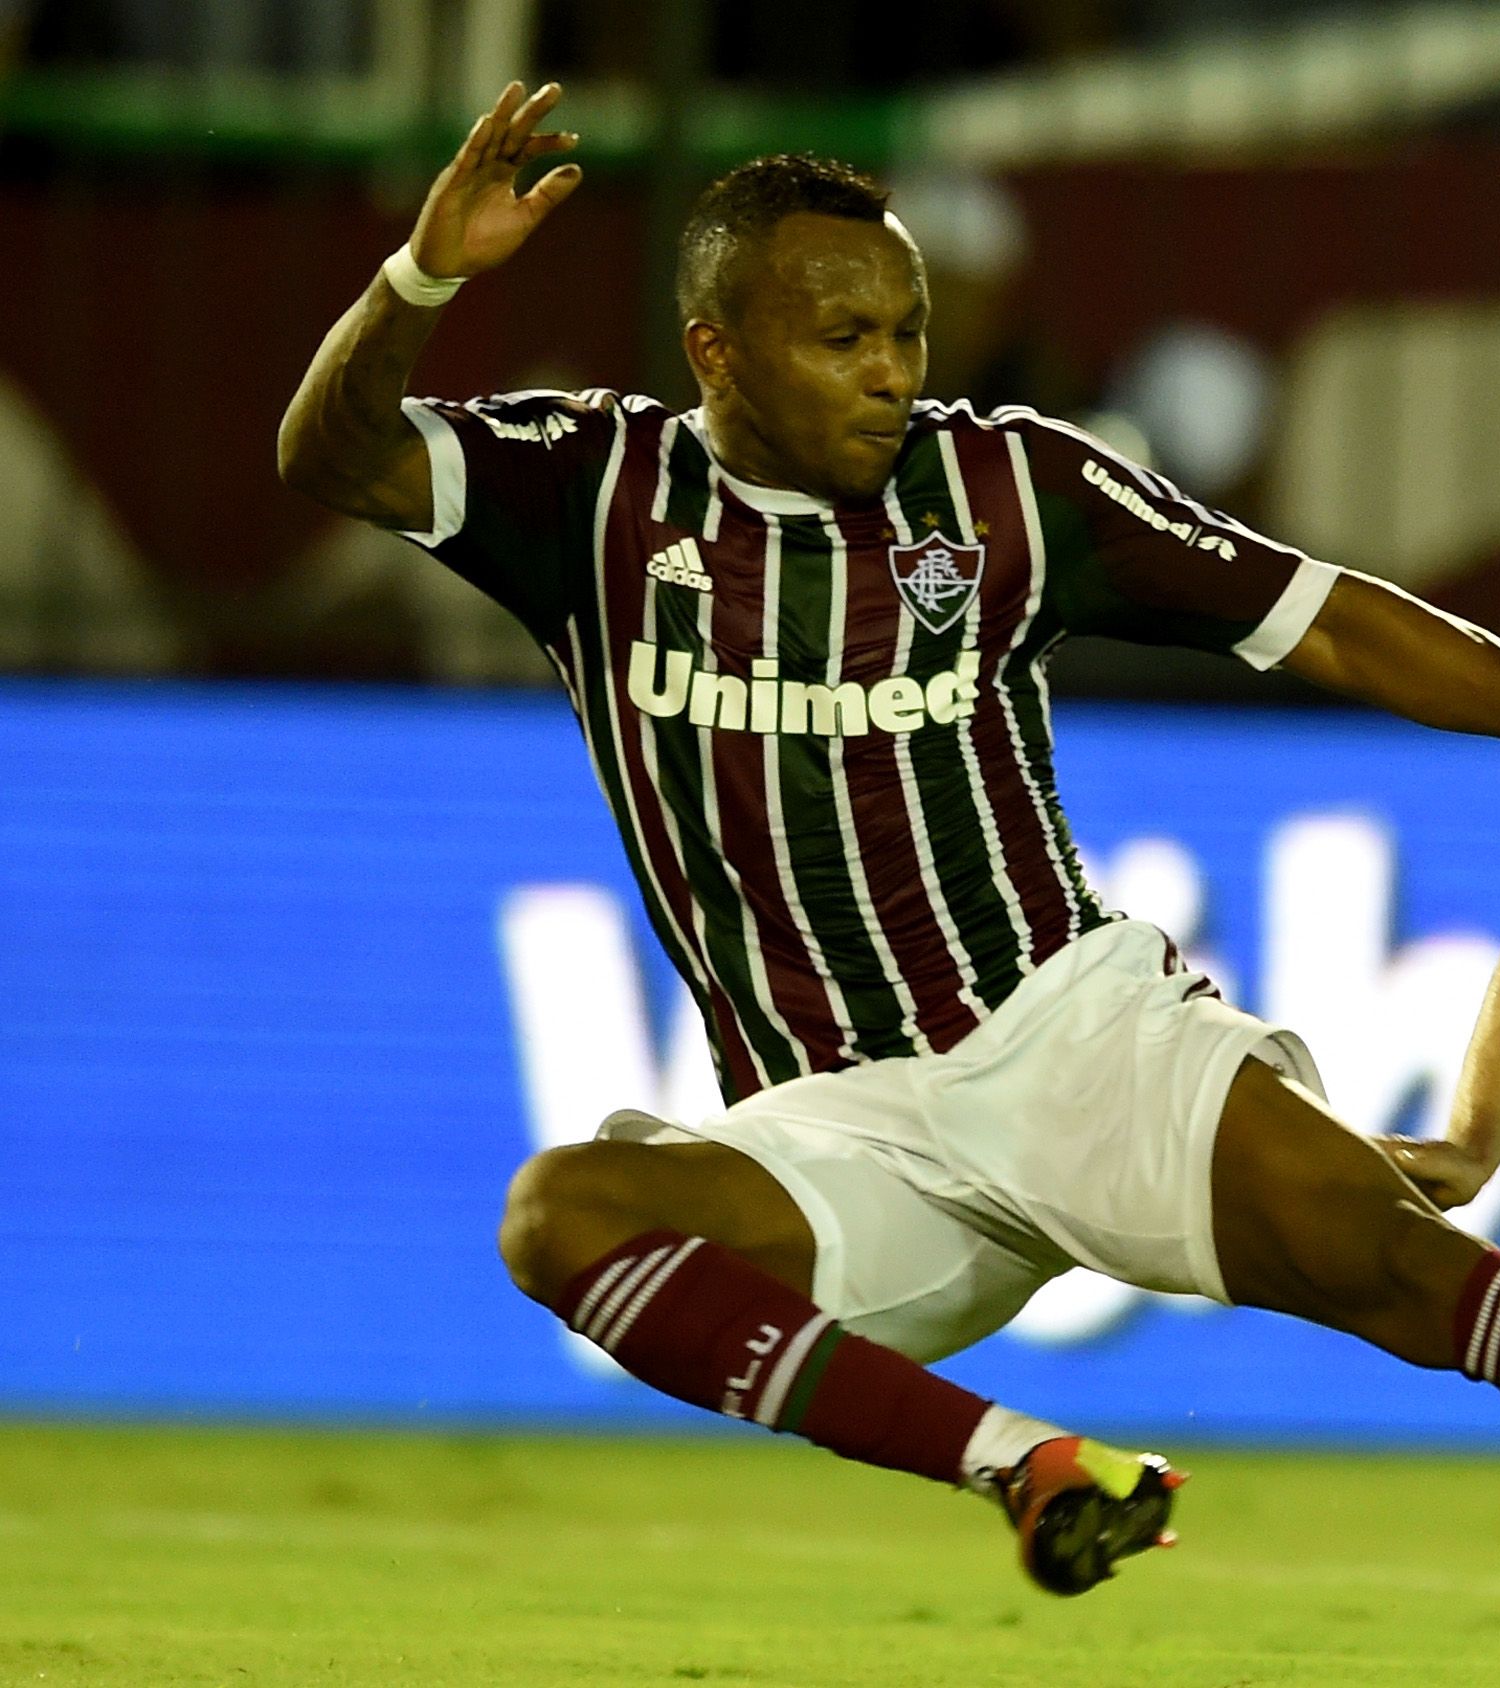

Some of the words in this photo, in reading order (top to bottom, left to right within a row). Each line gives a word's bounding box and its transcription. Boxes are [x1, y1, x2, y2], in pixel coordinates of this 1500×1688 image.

[1081, 459, 1193, 541] Unimed
[646, 560, 713, 591] adidas
[628, 640, 982, 737] Unimed
[721, 1324, 784, 1418] FLU
